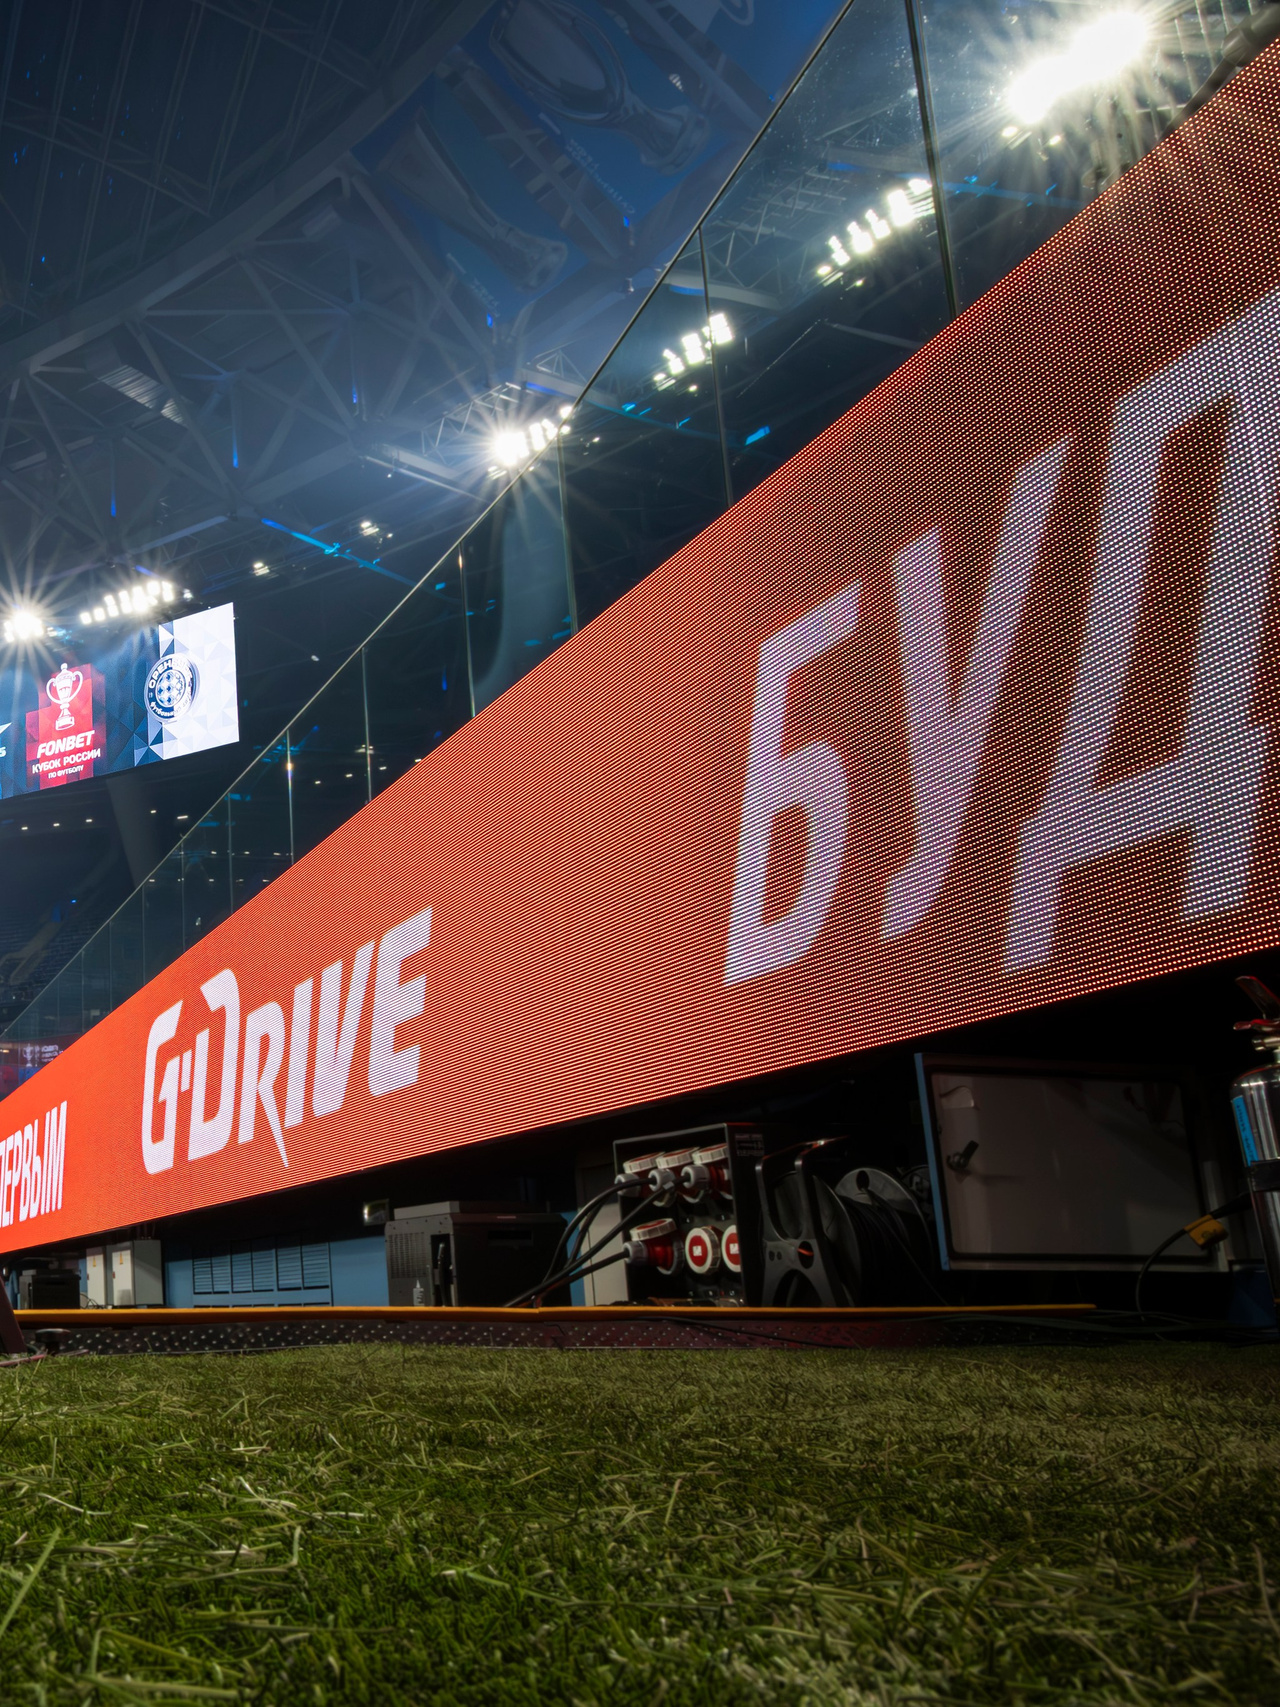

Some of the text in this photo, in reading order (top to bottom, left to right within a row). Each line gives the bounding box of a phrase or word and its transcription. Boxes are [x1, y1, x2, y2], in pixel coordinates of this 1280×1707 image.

[37, 730, 95, 758] FONBET
[32, 748, 100, 773] КУБОК РОССИИ
[57, 764, 84, 776] ФУТБОЛУ
